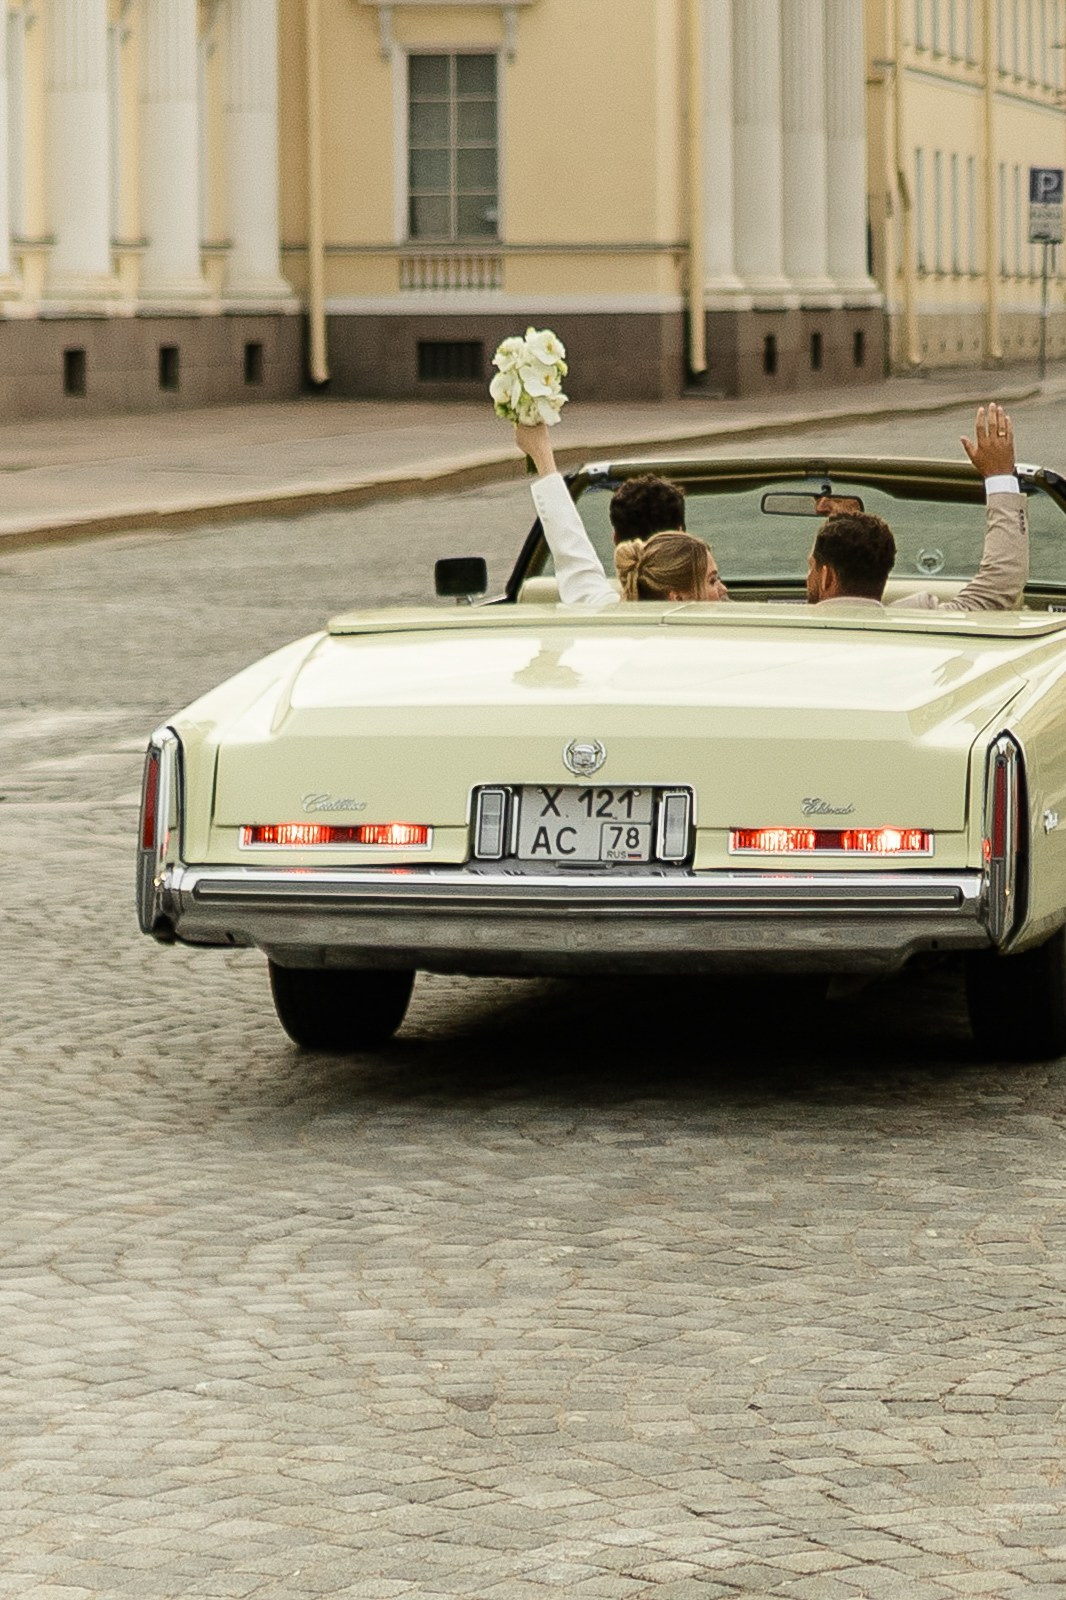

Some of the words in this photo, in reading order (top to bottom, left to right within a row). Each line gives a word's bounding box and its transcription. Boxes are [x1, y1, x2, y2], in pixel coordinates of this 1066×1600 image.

[1038, 172, 1059, 201] P
[577, 789, 634, 818] 121
[609, 826, 640, 849] 78
[606, 850, 627, 859] RUS
